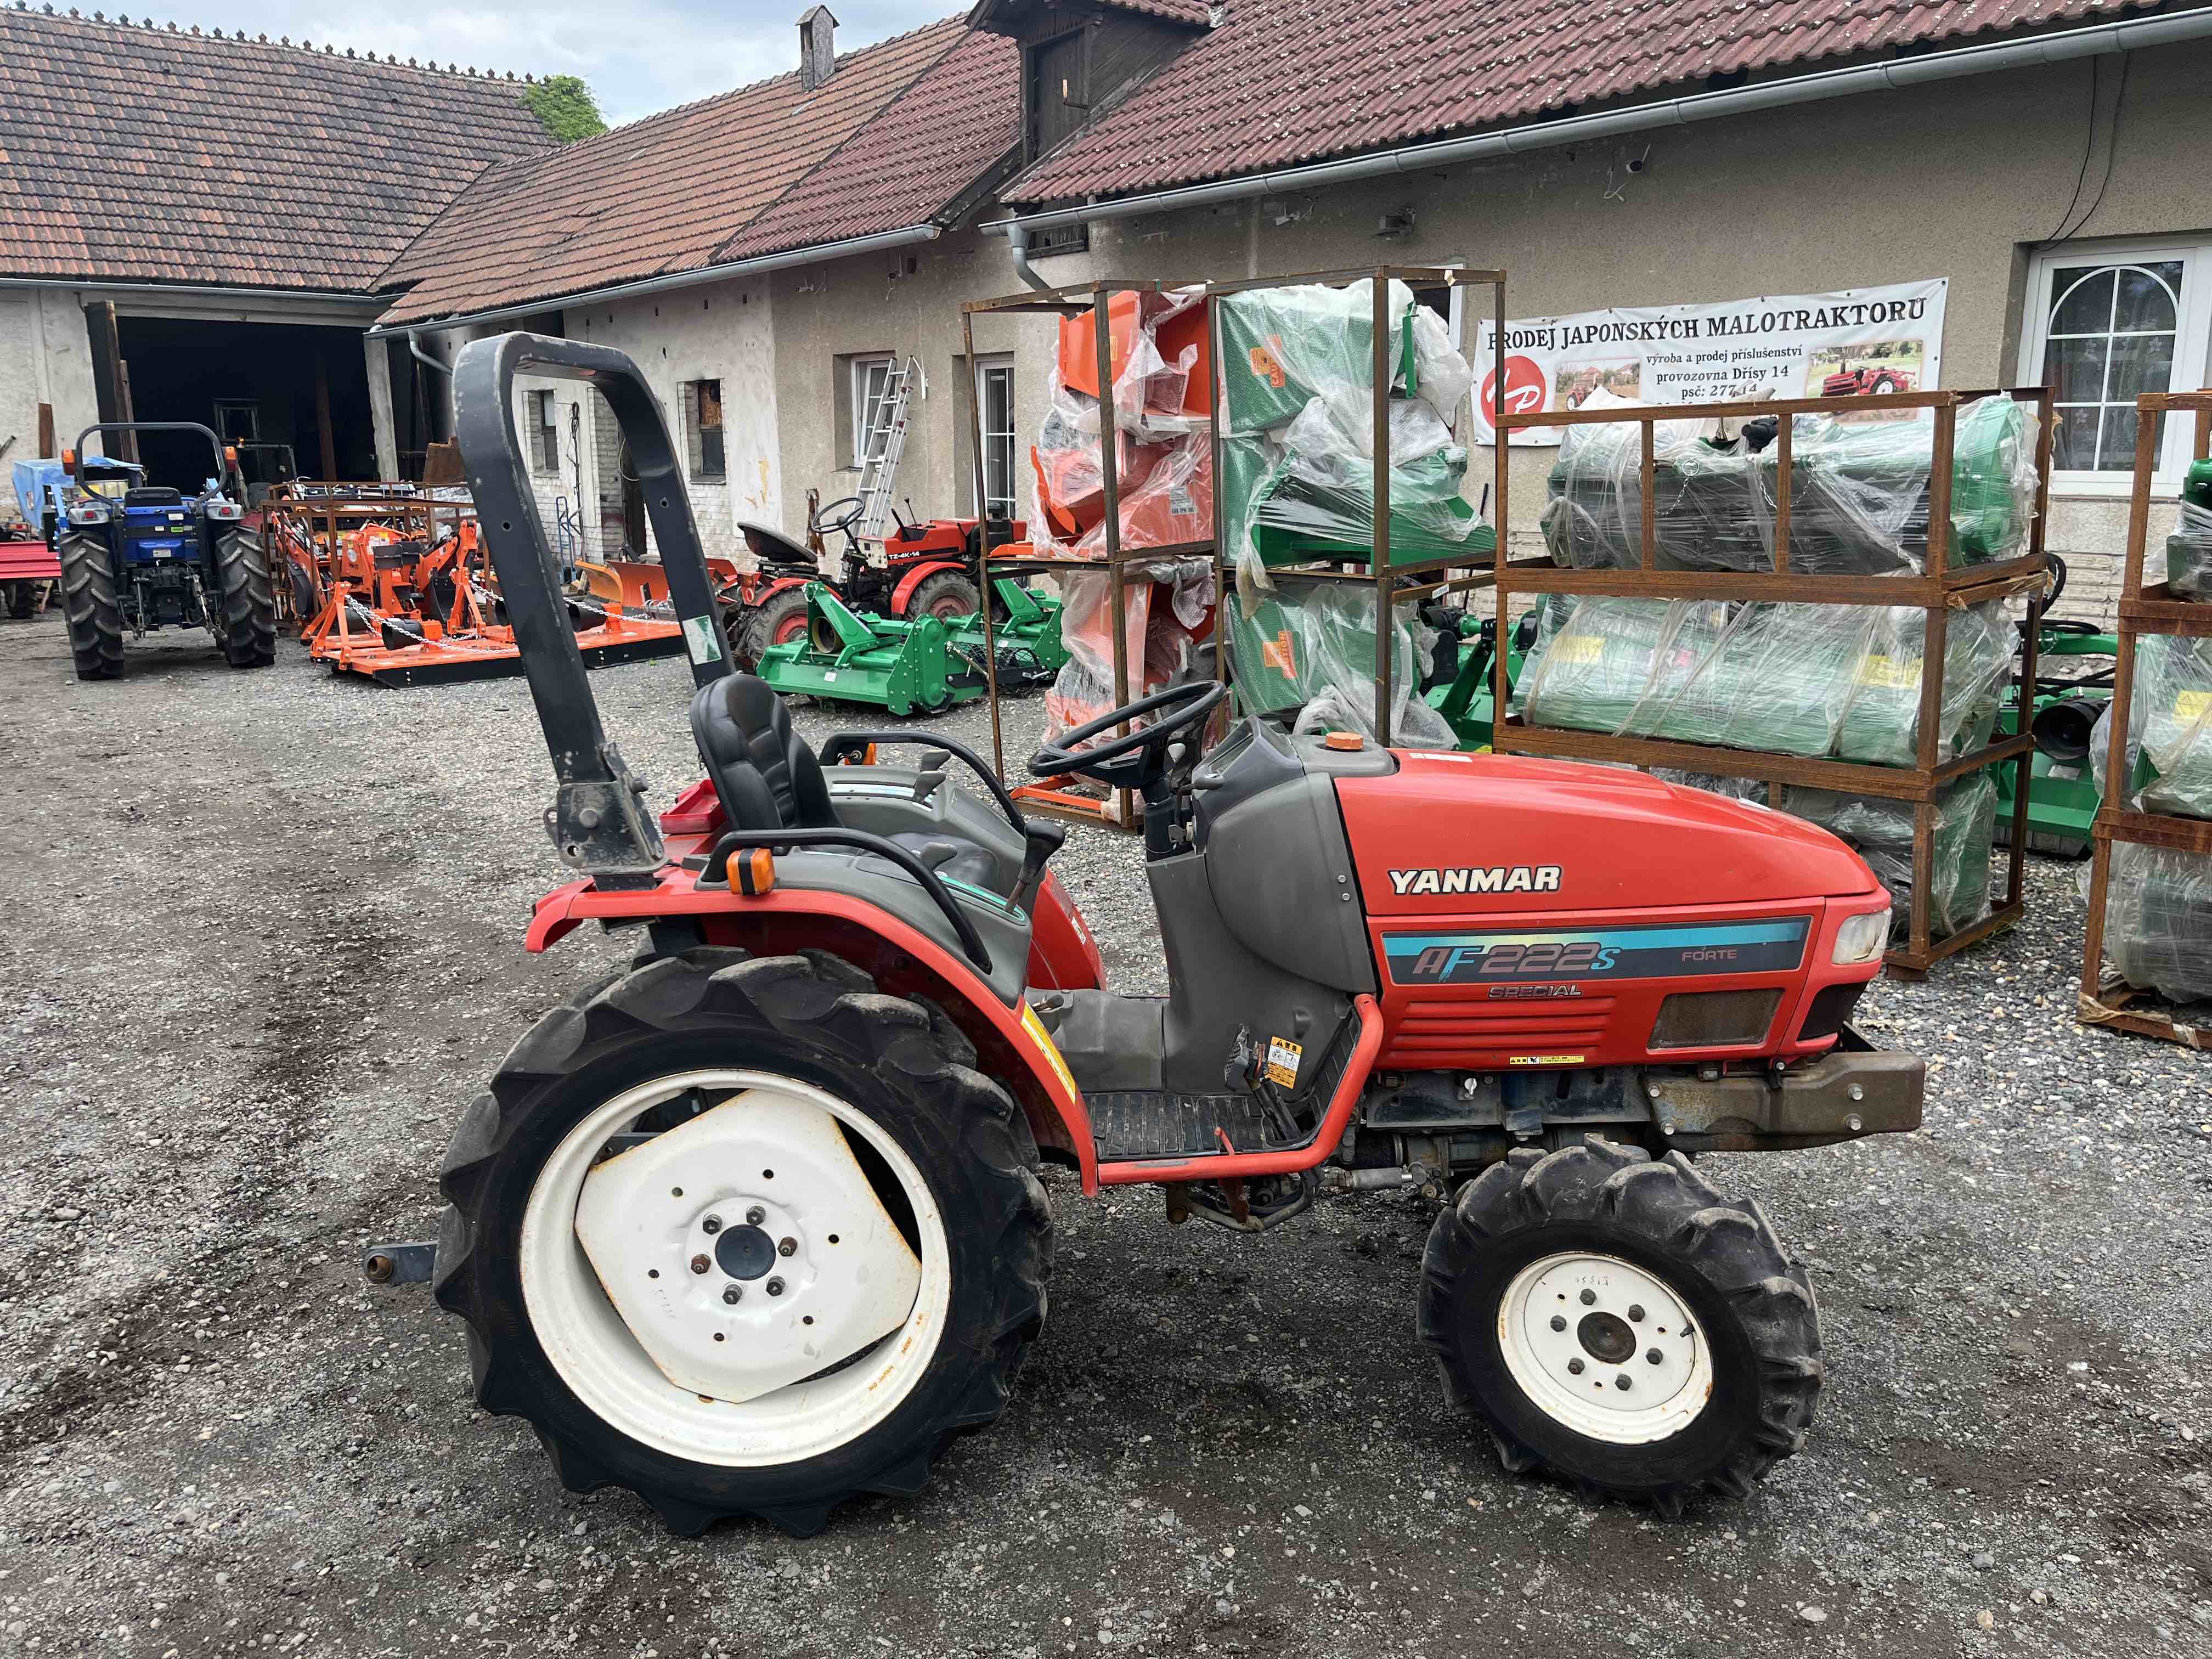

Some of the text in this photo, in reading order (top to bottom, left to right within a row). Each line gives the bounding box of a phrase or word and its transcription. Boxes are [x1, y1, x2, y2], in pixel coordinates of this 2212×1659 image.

[1561, 315, 1699, 350] JAPONSKÝCH
[1646, 345, 1803, 366] výroba a prodej příslušenství
[1656, 365, 1789, 385] provozovna Dřísy 14
[1681, 385, 1705, 400] psč:
[1709, 385, 1736, 397] 277
[1388, 865, 1561, 895] YANMAR
[1681, 949, 1738, 962] FORTE
[1488, 985, 1583, 998] SPECIAL
